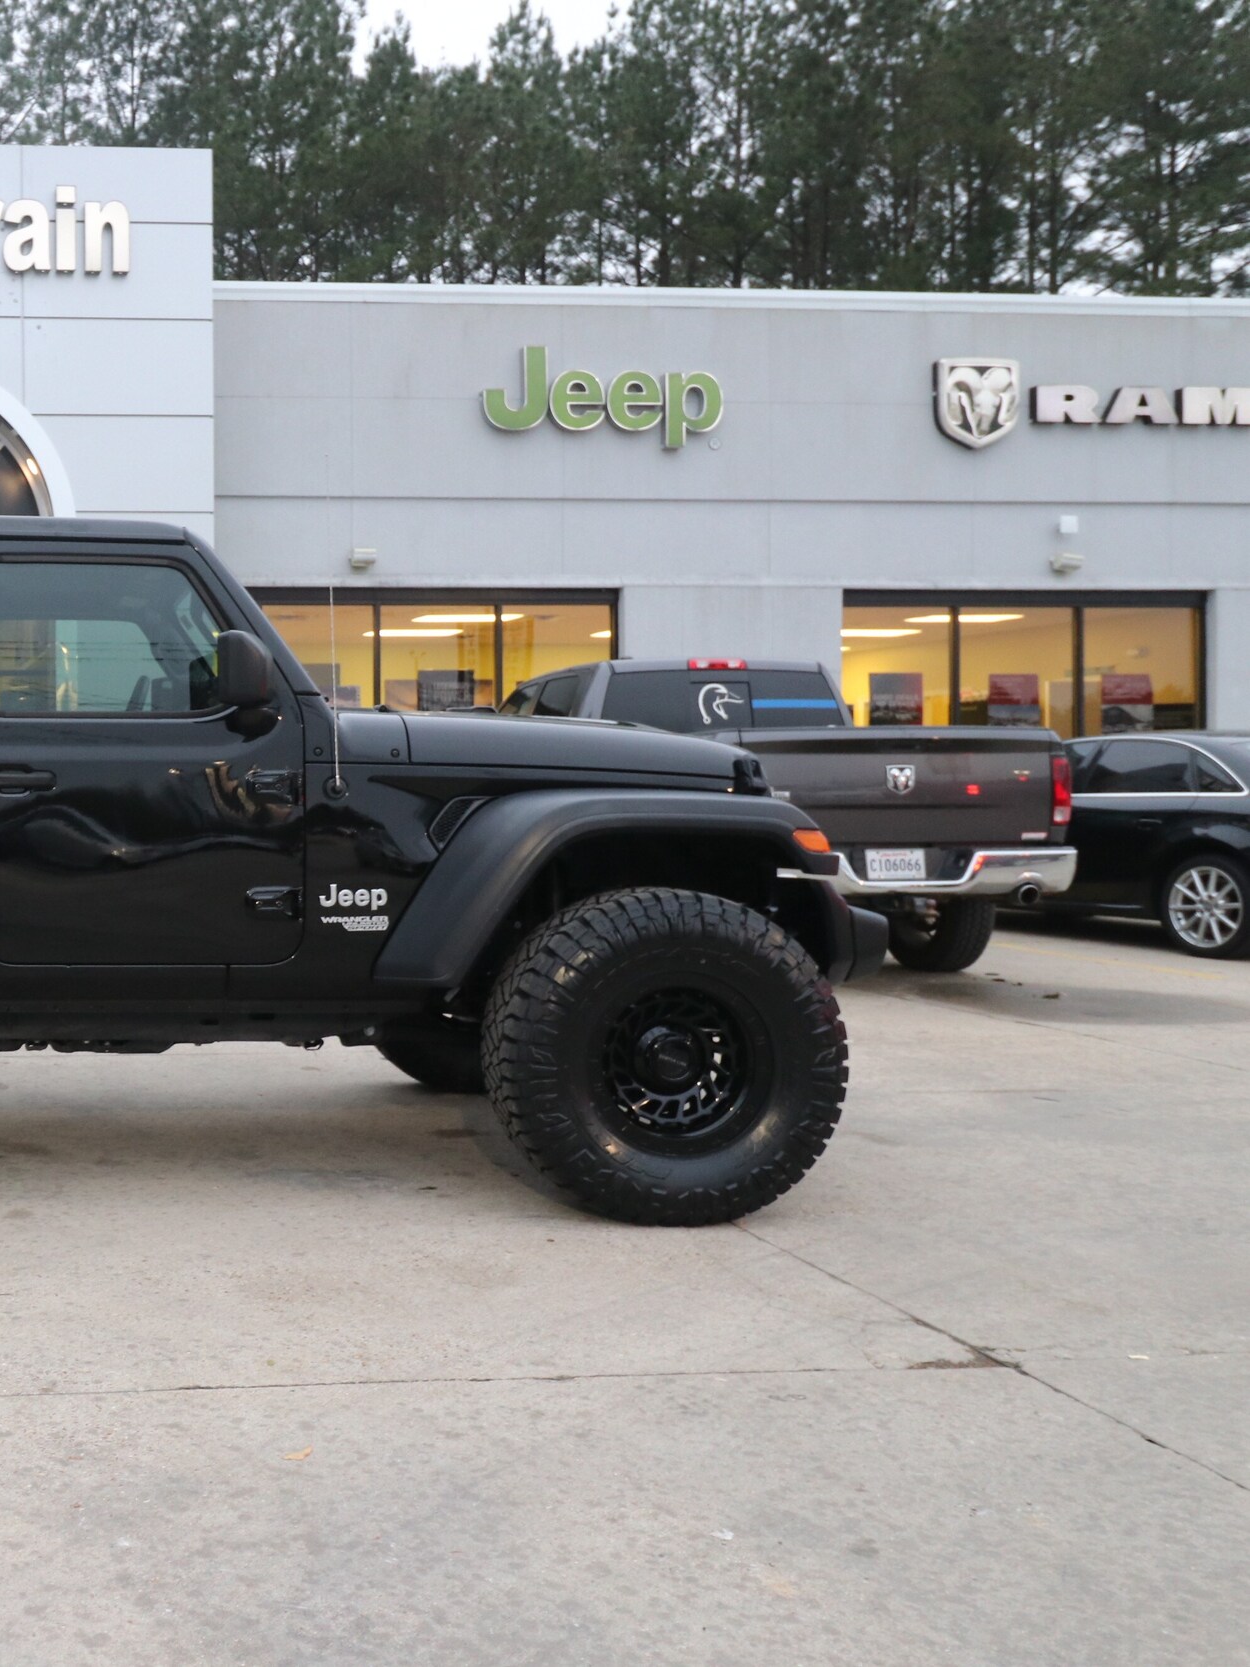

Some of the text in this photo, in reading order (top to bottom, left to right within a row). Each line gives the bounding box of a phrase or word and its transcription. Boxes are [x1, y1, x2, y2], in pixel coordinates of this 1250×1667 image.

[482, 345, 724, 449] Jeep
[1031, 384, 1250, 426] RAM
[318, 883, 388, 910] Jeep
[320, 915, 389, 923] WRANGLER
